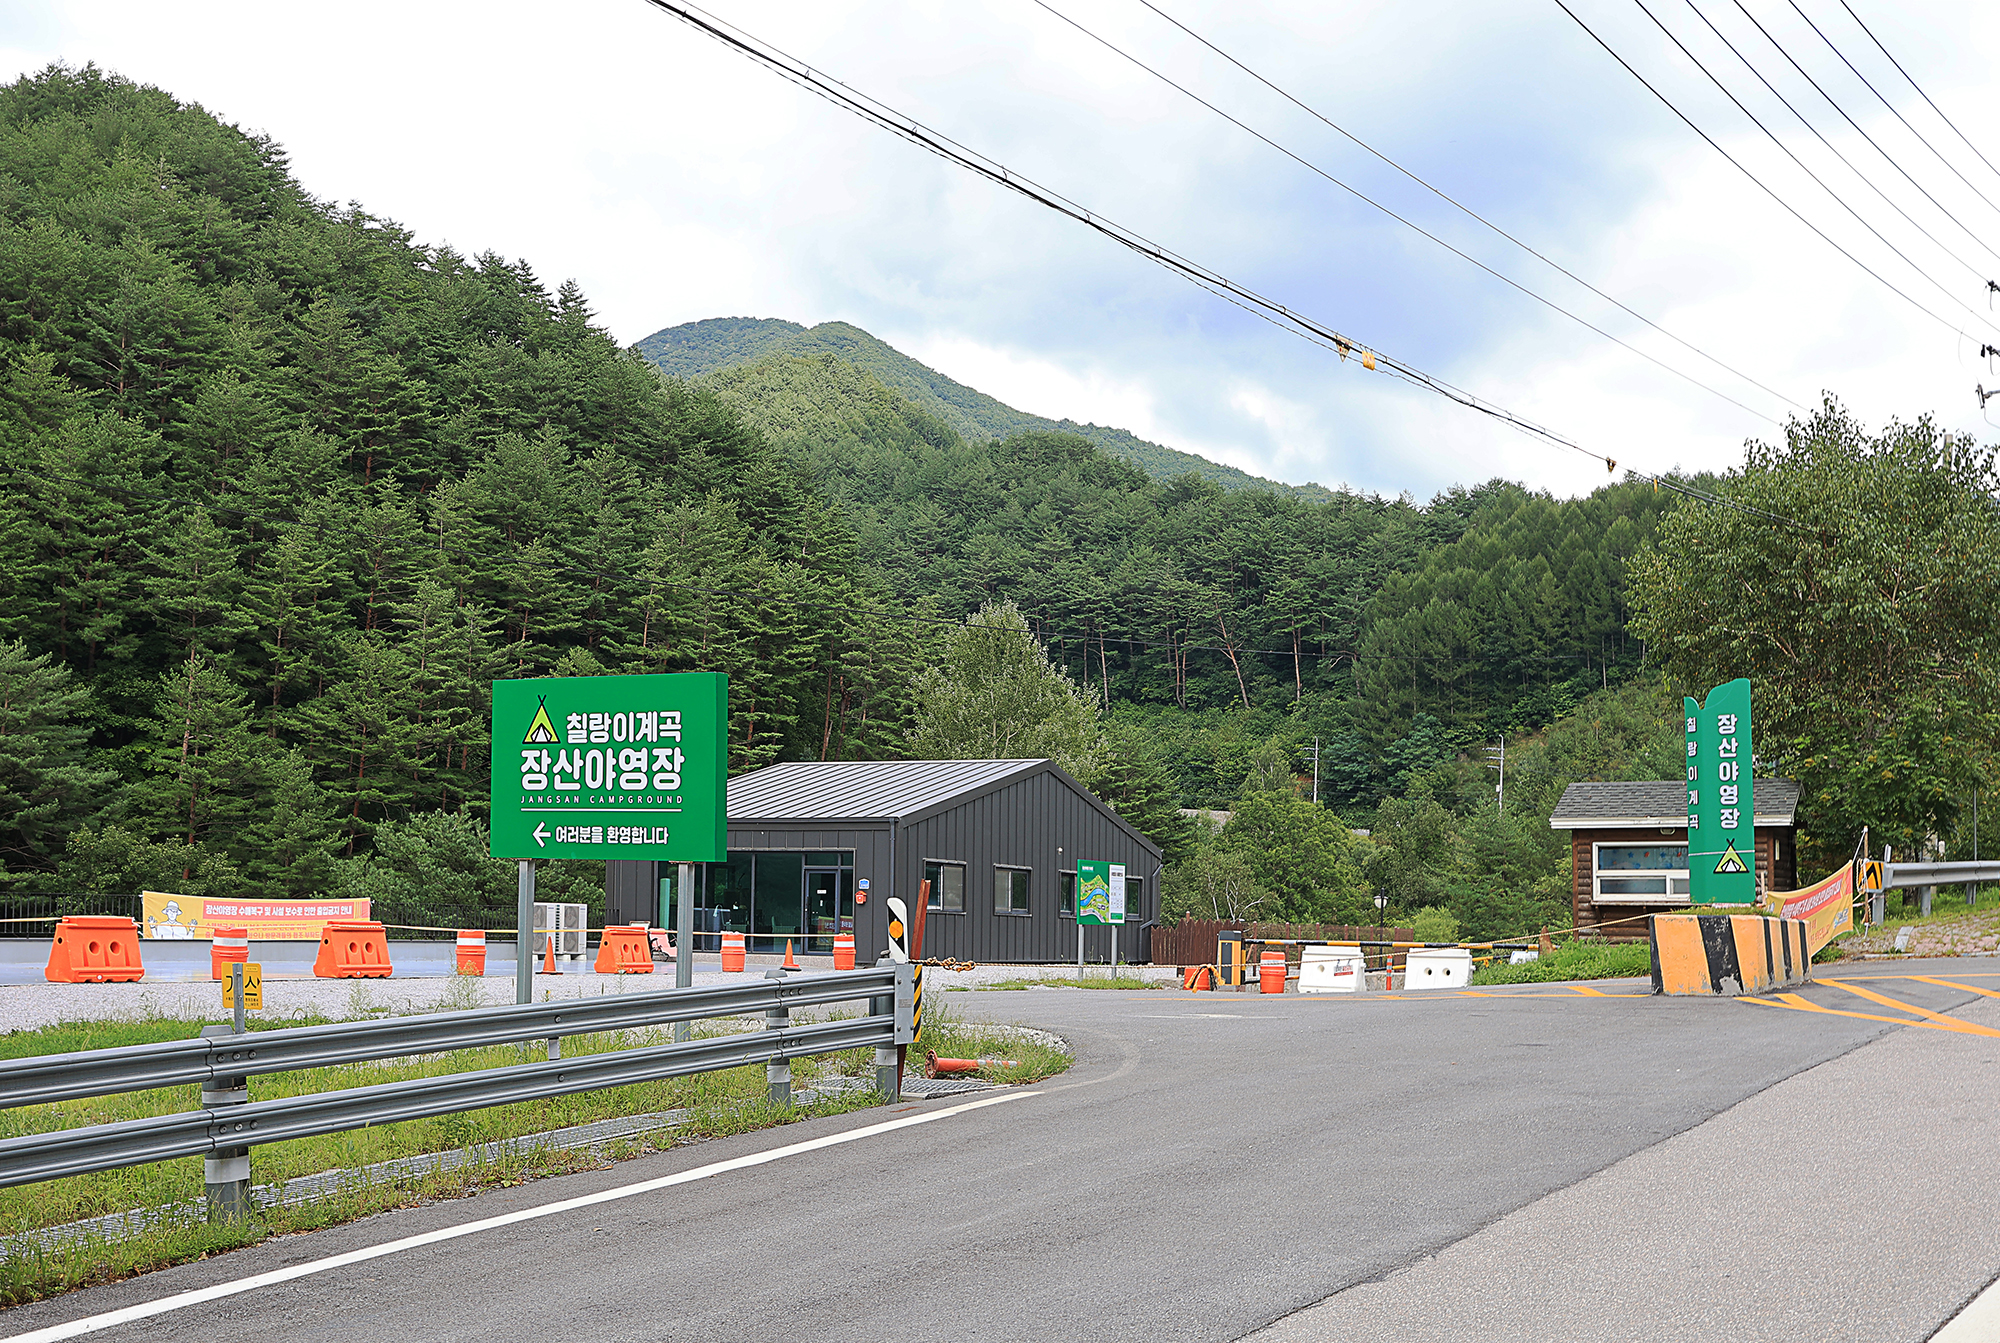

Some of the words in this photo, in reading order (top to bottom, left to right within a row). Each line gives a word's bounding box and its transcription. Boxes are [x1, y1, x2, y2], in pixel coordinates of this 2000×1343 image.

[566, 711, 682, 743] 칠랑이계곡
[520, 747, 686, 790] 장산야영장
[1687, 717, 1699, 830] 칠랑이계곡
[1717, 713, 1740, 829] 장산야영장
[520, 796, 580, 804] JANGSAN
[590, 796, 683, 804] CAMPGROUND
[556, 826, 603, 844] 여러분을
[607, 826, 669, 845] 환영합니다
[205, 904, 238, 915] 장산야영장
[264, 906, 271, 916] 및
[272, 906, 284, 916] 시설
[285, 906, 303, 916] 보수로
[304, 905, 316, 916] 인한
[317, 905, 339, 915] 출입금지
[340, 905, 352, 915] 안내
